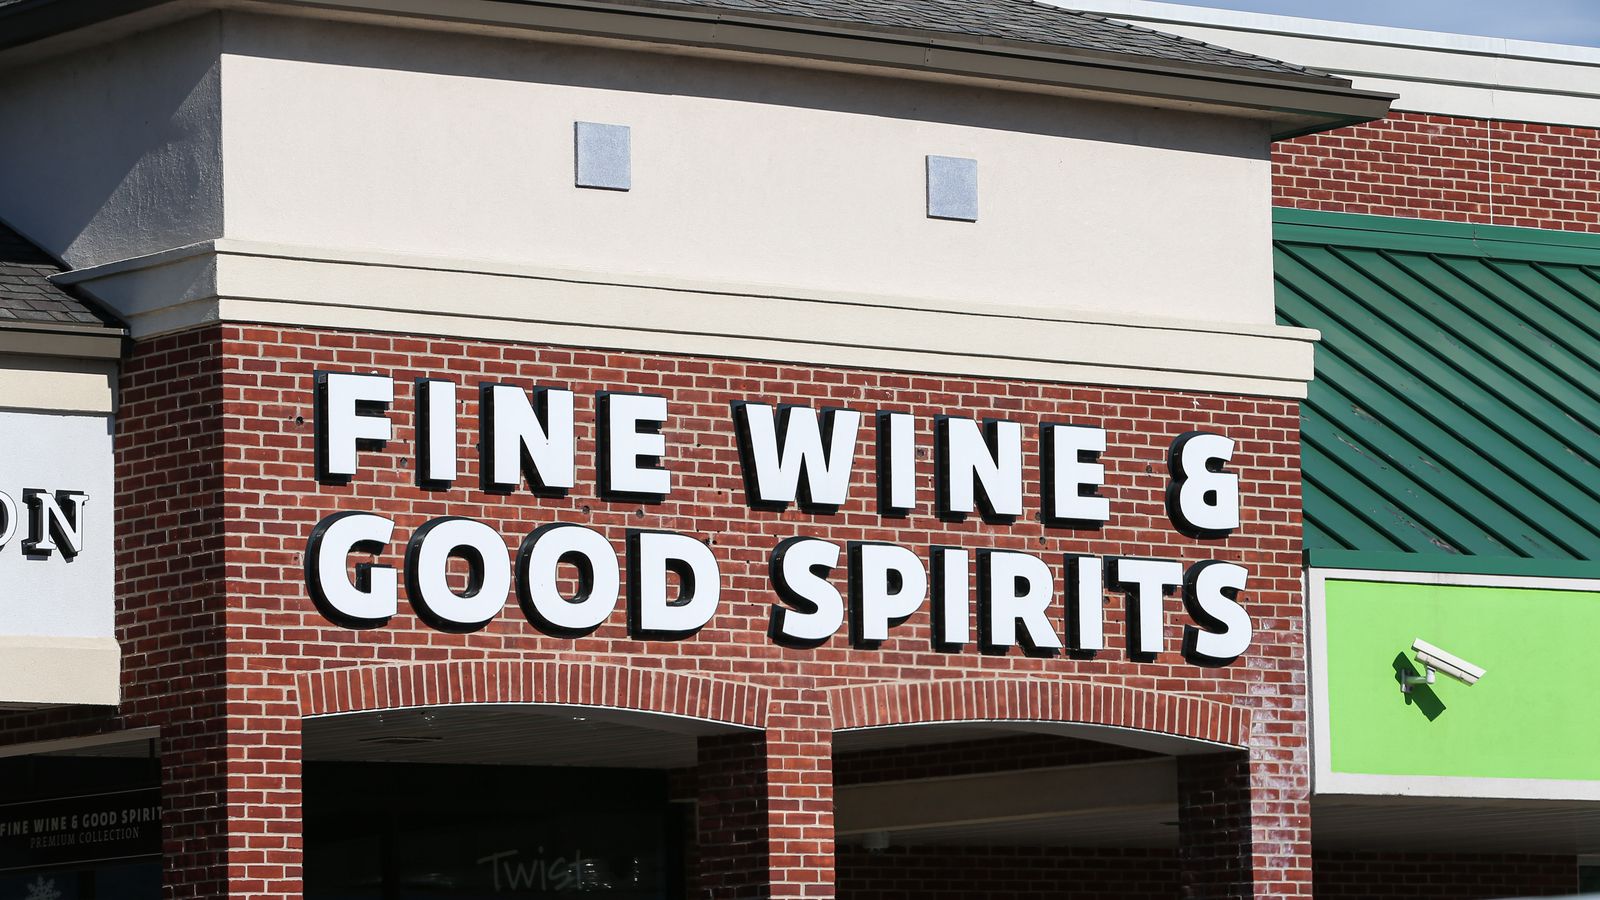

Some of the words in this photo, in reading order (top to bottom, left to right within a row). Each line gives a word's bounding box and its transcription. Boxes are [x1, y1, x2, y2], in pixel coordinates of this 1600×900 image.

[315, 371, 672, 499] FINE
[732, 400, 1111, 528] WINE
[1168, 431, 1241, 537] &
[306, 511, 721, 637] GOOD
[769, 537, 1254, 666] SPIRITS
[0, 820, 29, 837] FINE
[34, 816, 68, 834] WINE
[71, 814, 79, 830] &
[82, 811, 118, 828] GOOD
[30, 834, 75, 849] PREMIUM
[79, 827, 140, 844] COLLECTION
